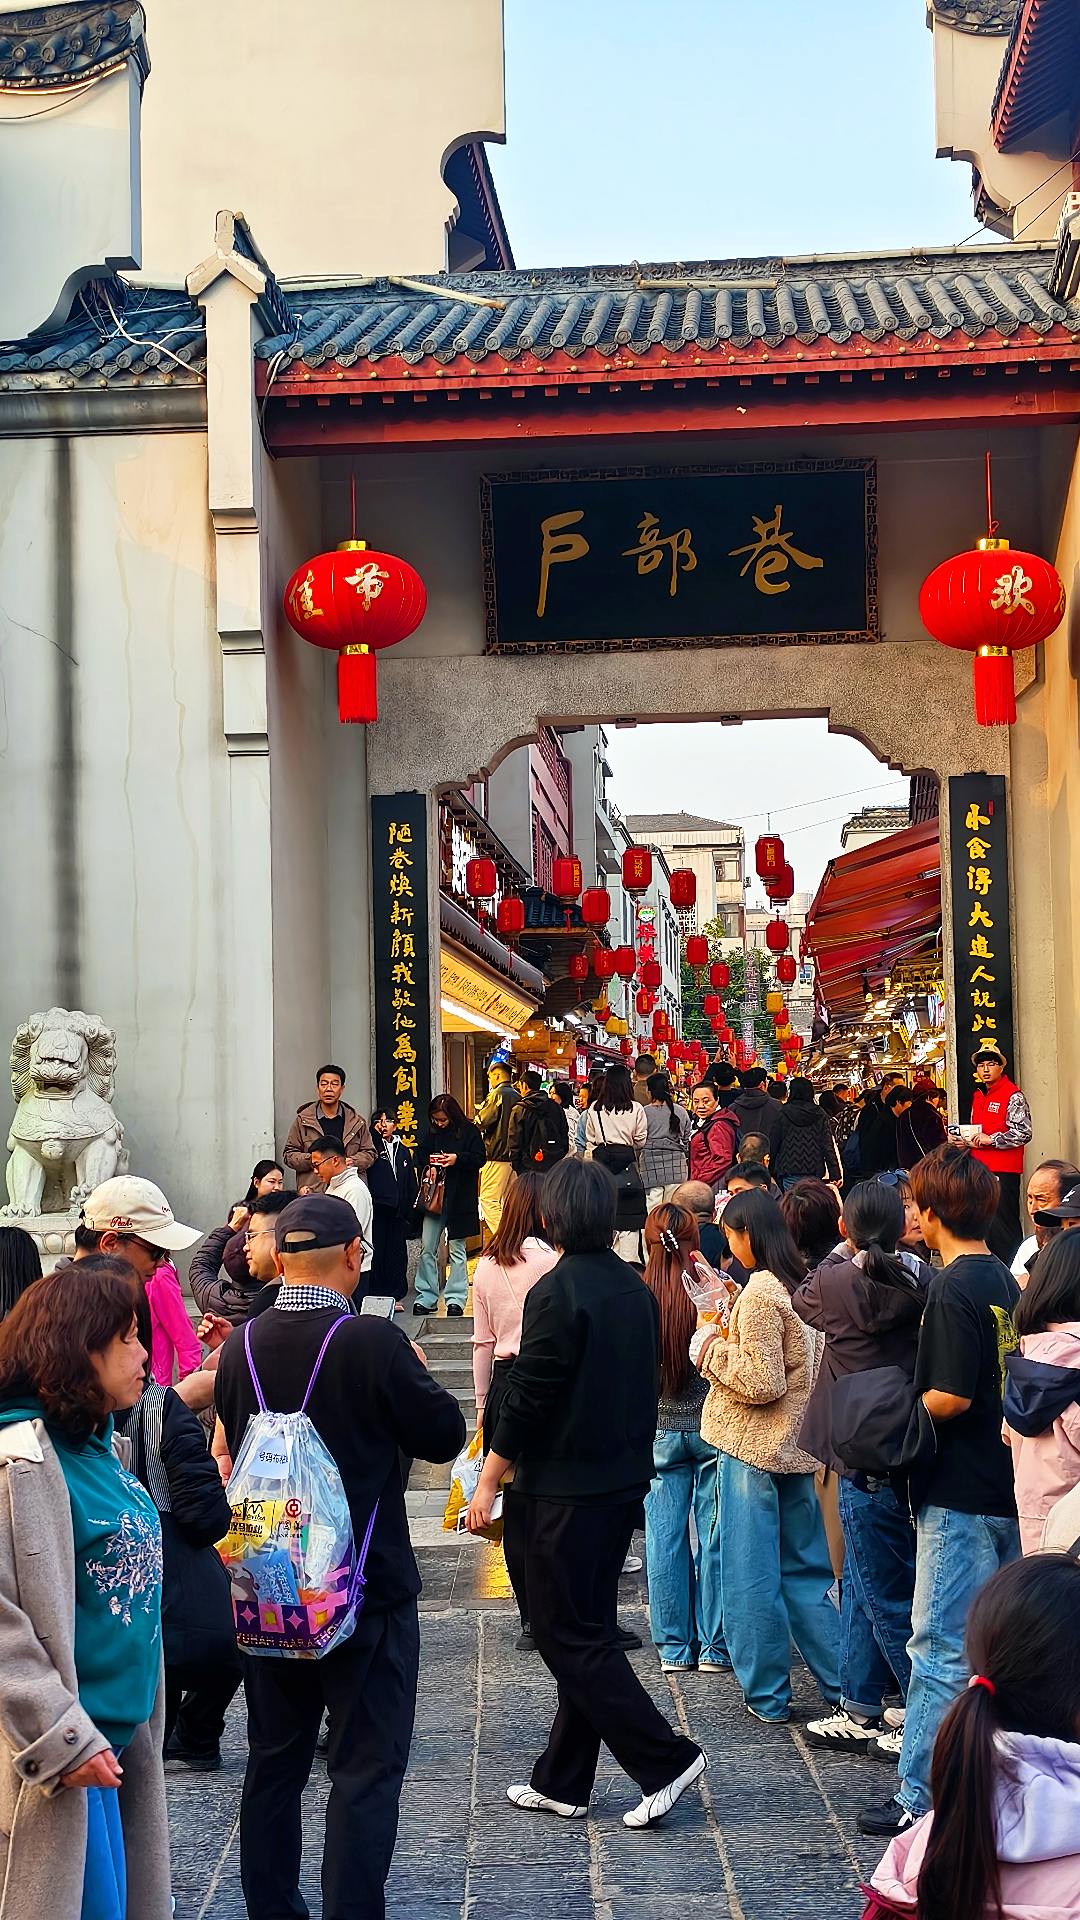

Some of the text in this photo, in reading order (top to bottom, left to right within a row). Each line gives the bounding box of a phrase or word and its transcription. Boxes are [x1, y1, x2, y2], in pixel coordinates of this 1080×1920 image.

[536, 504, 824, 618] 户部巷
[990, 565, 1065, 615] 欢
